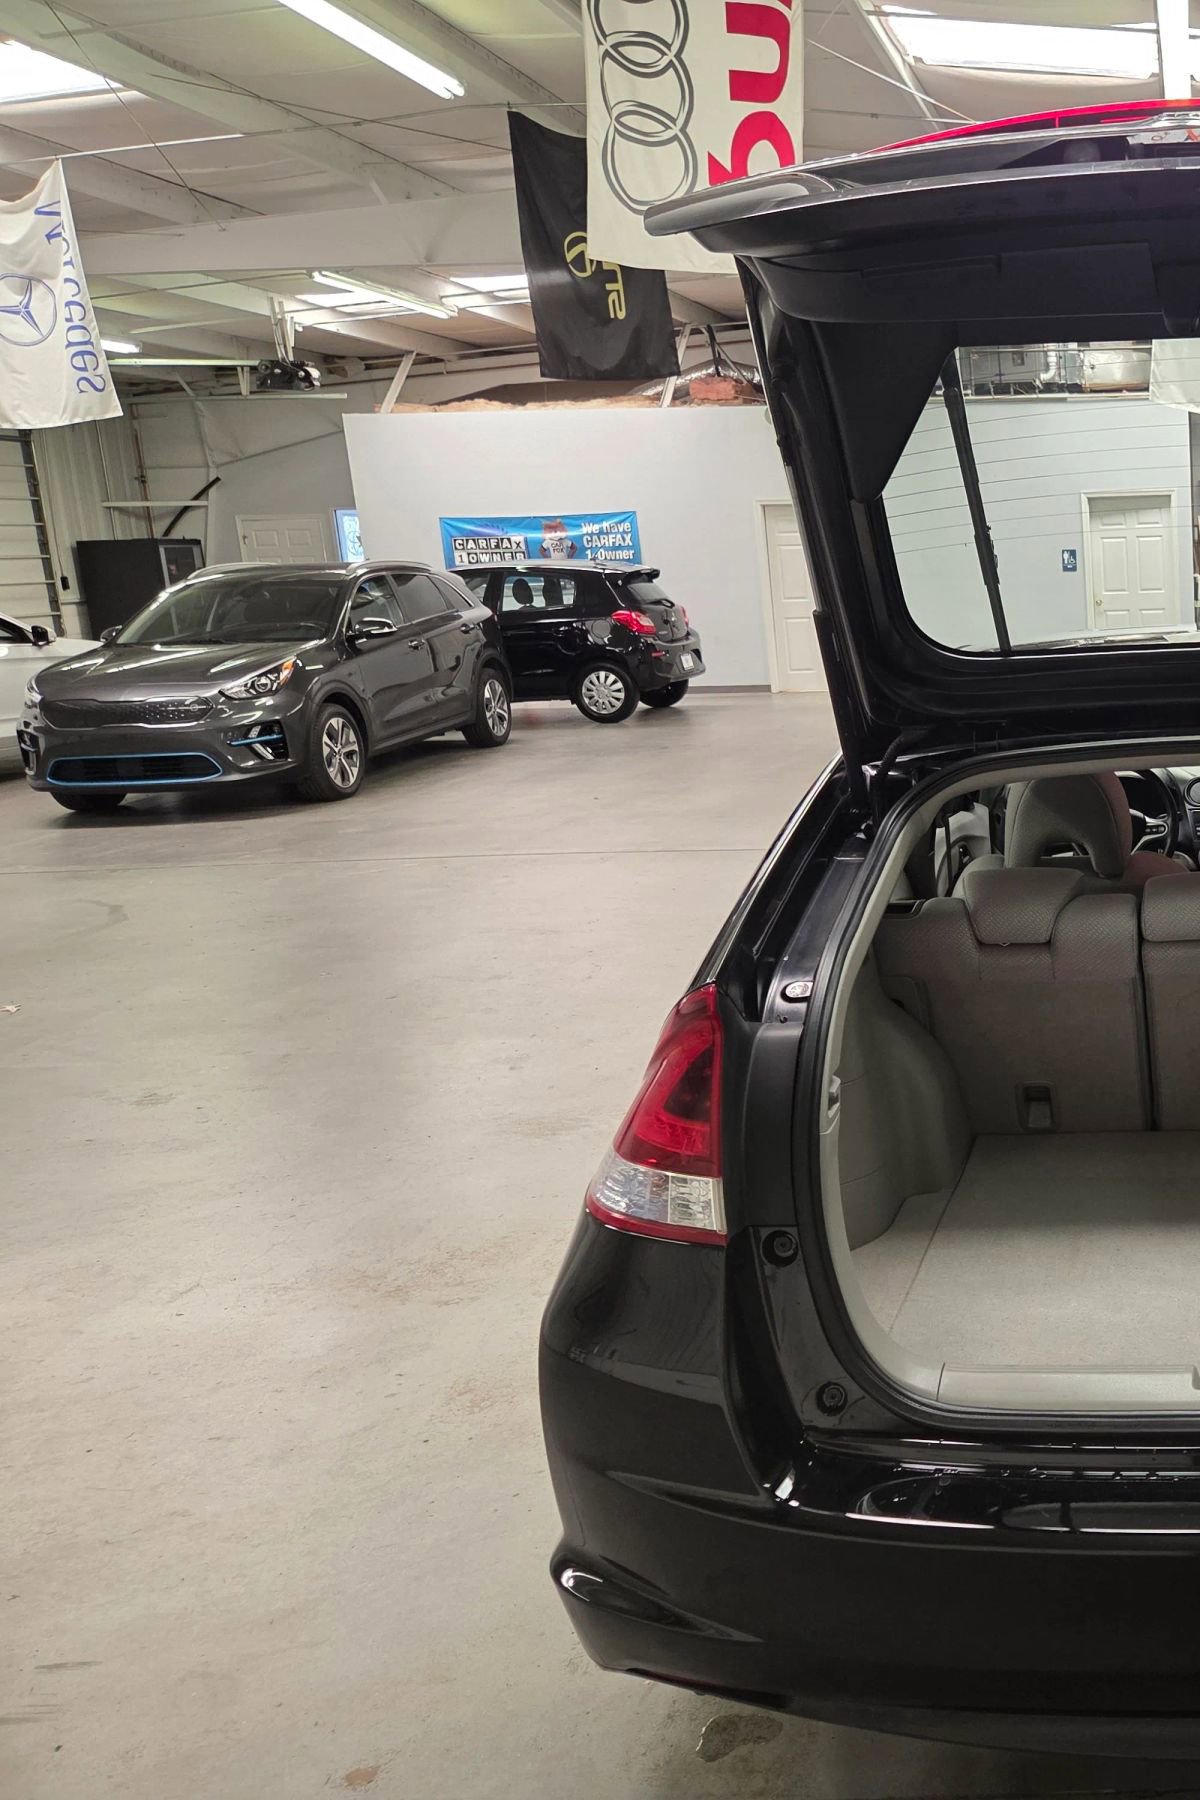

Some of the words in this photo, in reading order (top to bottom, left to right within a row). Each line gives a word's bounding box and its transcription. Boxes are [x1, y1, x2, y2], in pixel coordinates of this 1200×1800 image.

[581, 522, 599, 534] We
[602, 521, 632, 533] have
[455, 538, 522, 550] CARFAX
[583, 534, 633, 547] CARFAX
[468, 552, 525, 564] OWNER
